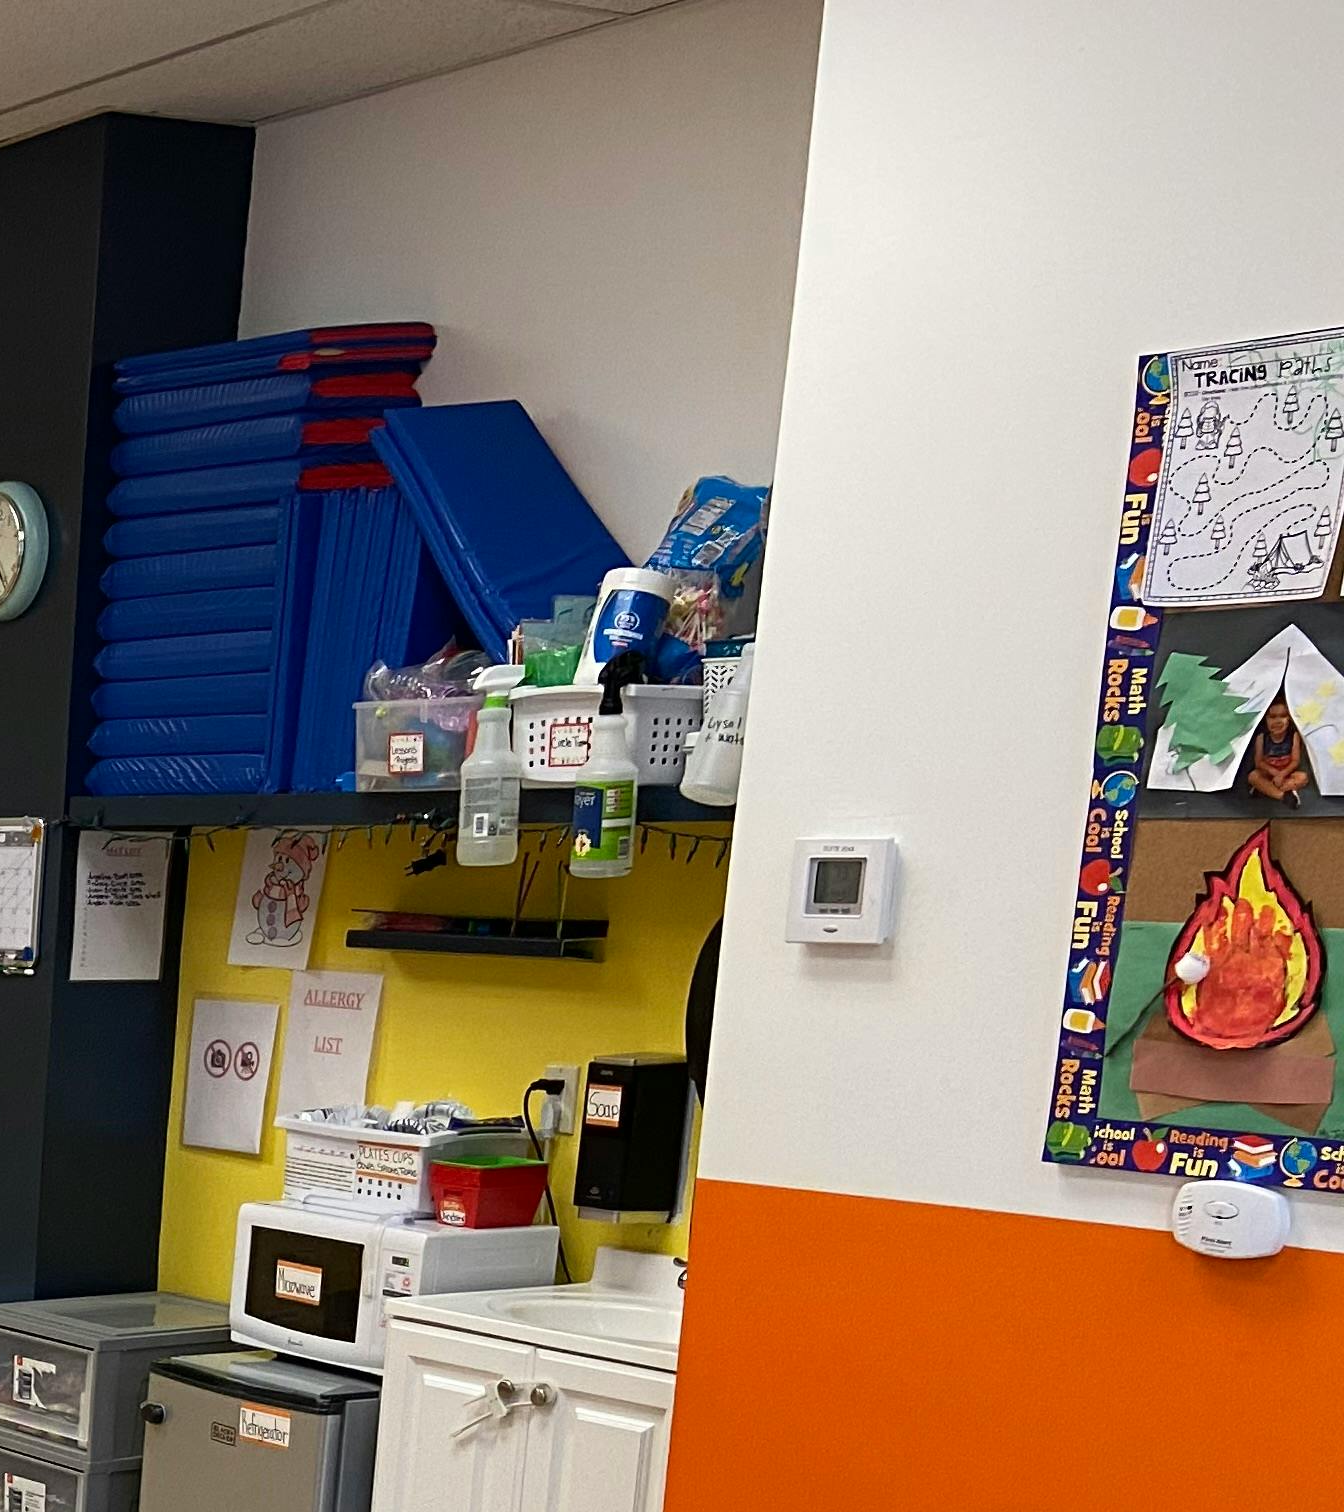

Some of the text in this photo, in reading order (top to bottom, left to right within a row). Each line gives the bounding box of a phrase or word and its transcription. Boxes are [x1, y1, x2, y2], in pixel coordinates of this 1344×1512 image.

[1135, 407, 1152, 444] ool
[1119, 493, 1148, 544] Fun
[1103, 659, 1129, 722] Rocks
[1126, 667, 1149, 715] Math
[1085, 807, 1108, 854] Cool
[1109, 809, 1130, 860] School
[1070, 899, 1098, 950] Fun
[1095, 895, 1121, 957] Reading
[303, 989, 365, 1010] ALLERGY
[313, 1036, 344, 1055] LIST
[587, 1091, 619, 1119] Soap
[1053, 1057, 1079, 1120] Rocks
[1076, 1068, 1097, 1115] Math
[358, 1145, 415, 1166] PLATES CUPS
[1102, 1139, 1114, 1152] is
[1169, 1129, 1229, 1150] Reading
[1193, 1146, 1204, 1158] is
[1089, 1150, 1126, 1168] ool
[1169, 1152, 1219, 1179] Fun
[1313, 1169, 1344, 1190] Co
[242, 1409, 289, 1445] Refrigerator
